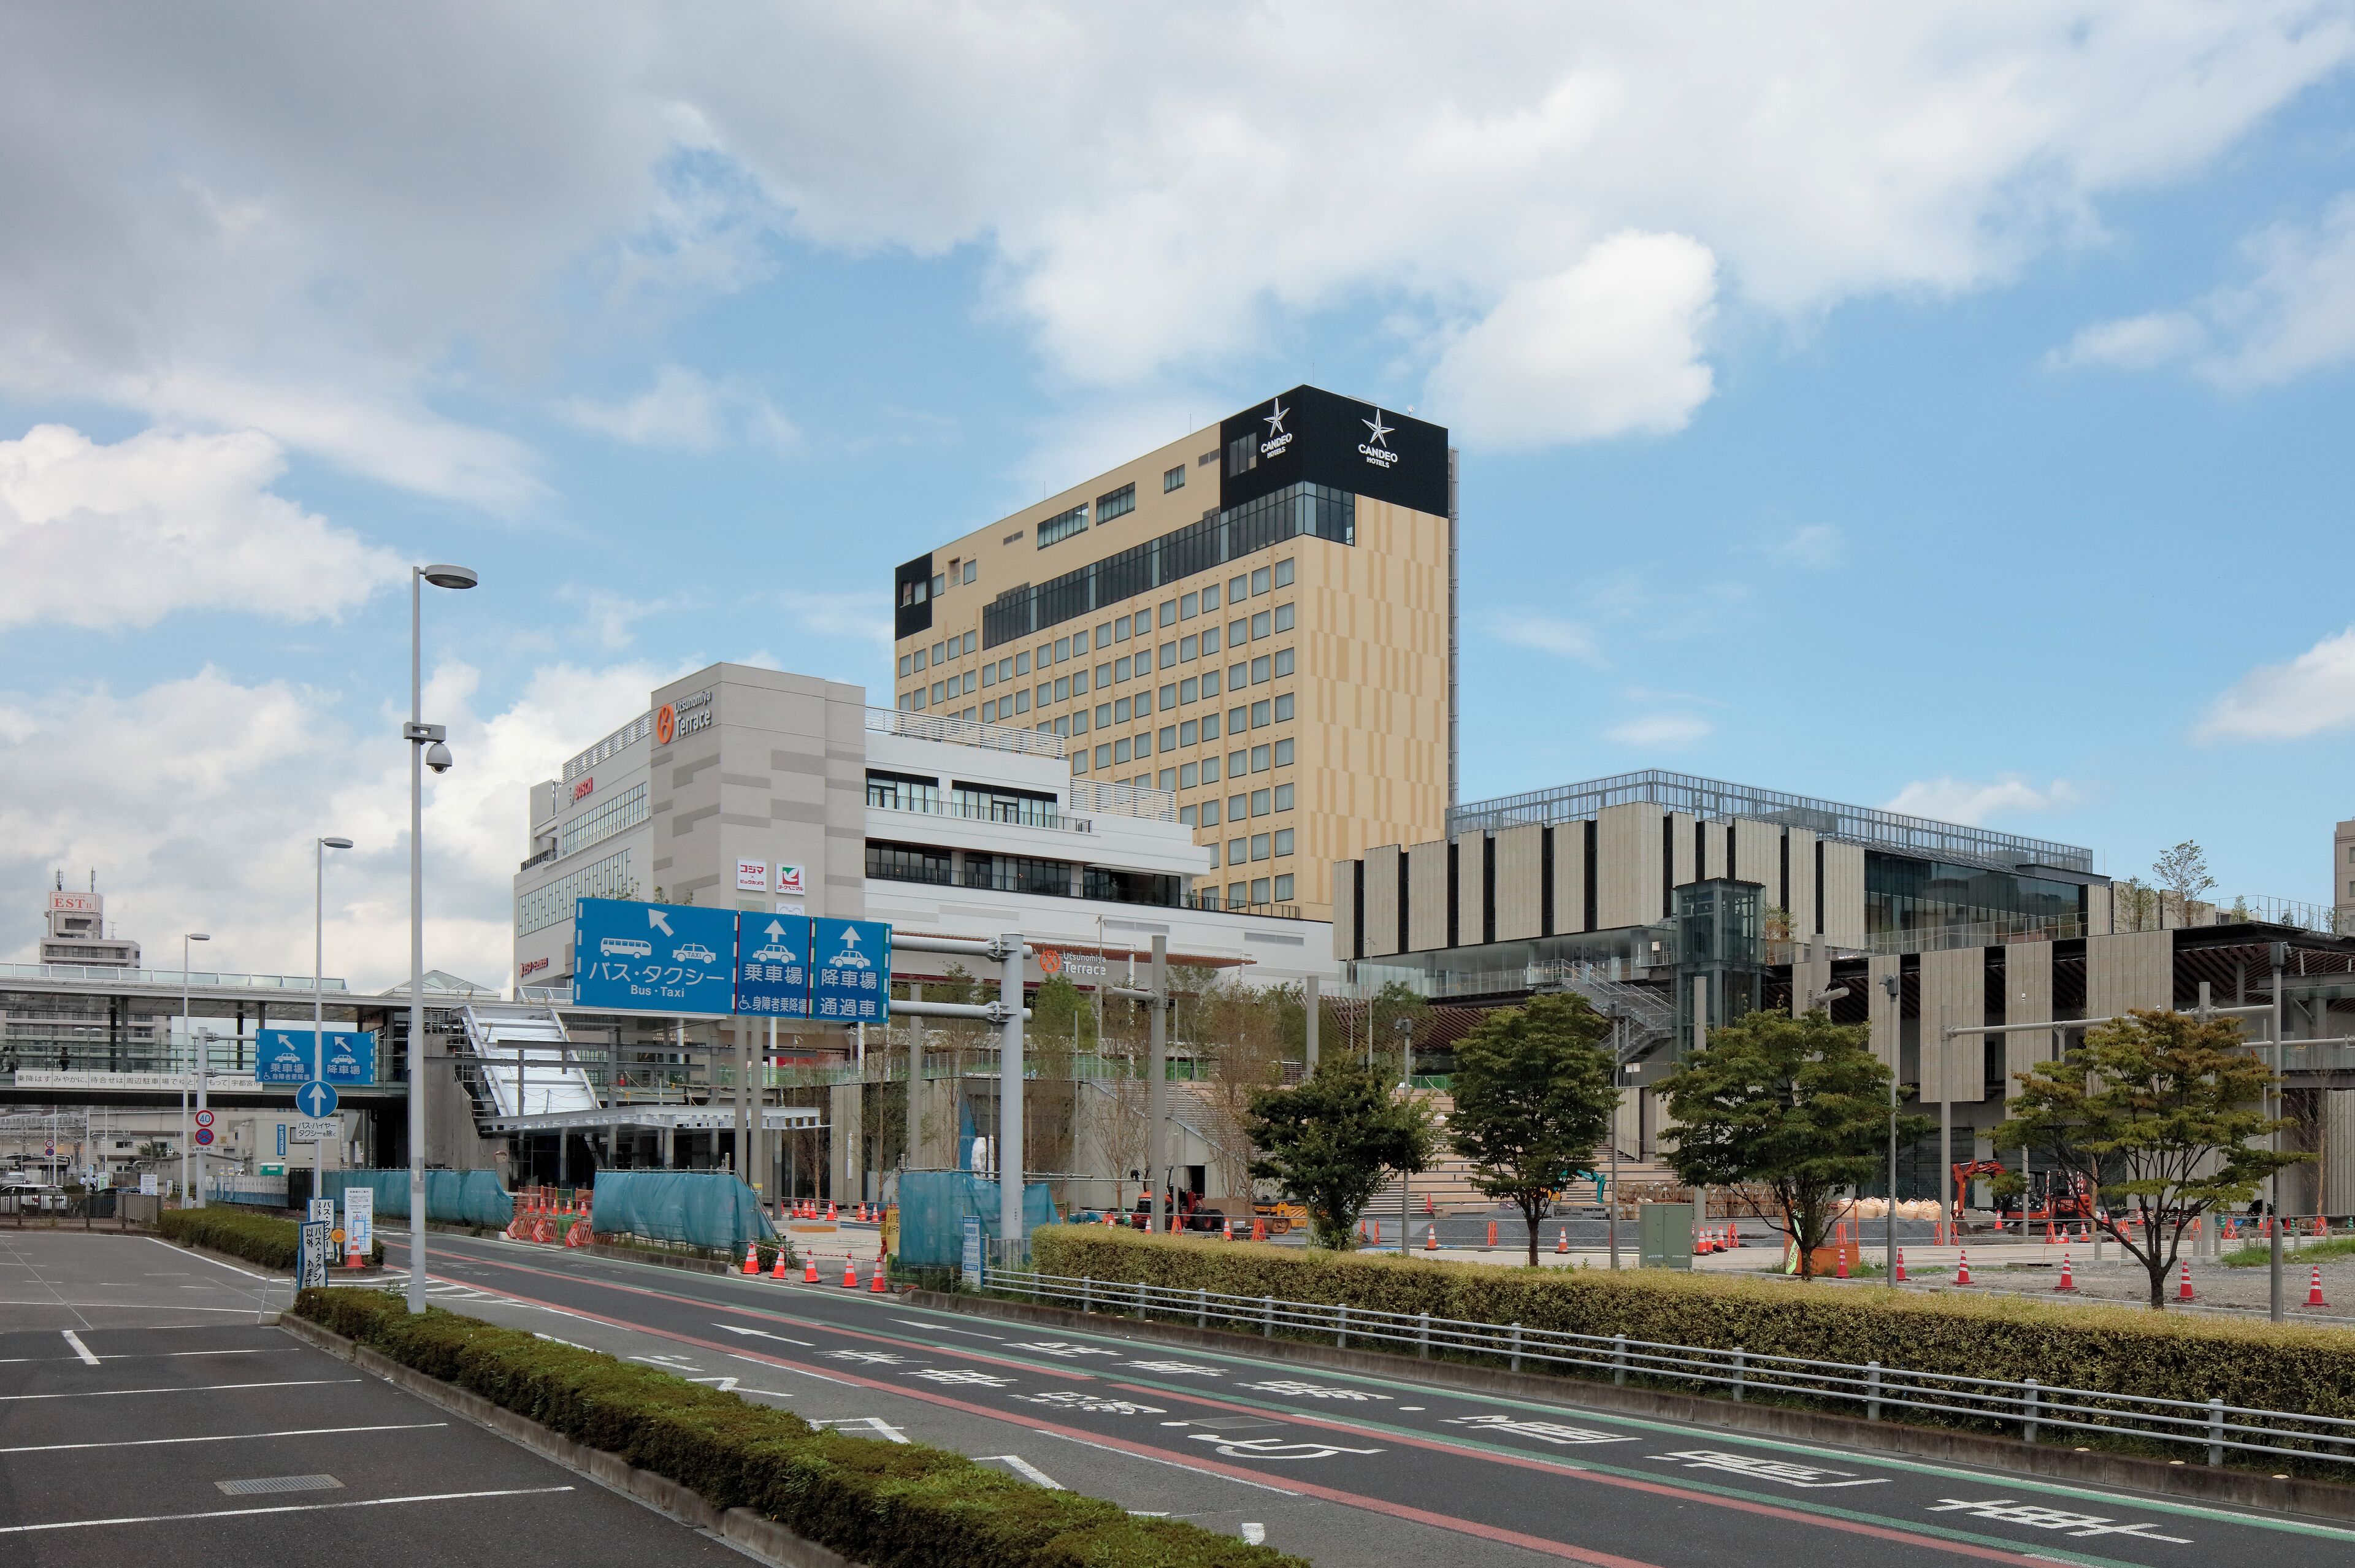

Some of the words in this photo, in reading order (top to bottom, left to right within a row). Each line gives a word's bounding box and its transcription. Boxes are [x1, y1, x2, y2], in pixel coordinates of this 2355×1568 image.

[1261, 433, 1293, 453] CANDEO
[1267, 446, 1286, 459] HOTELS
[1358, 444, 1398, 463] CANDEO
[1366, 457, 1390, 468] HOTELS
[675, 690, 711, 713] Utsunomiya
[675, 709, 711, 736] Terrace
[575, 777, 593, 800] BOSCH
[740, 865, 764, 874] コジマ
[54, 898, 85, 908] EST
[1063, 952, 1106, 963] Utsunomiya
[589, 962, 725, 985] バス・タクシー
[744, 963, 803, 985] 乗車場
[1063, 961, 1106, 976] Terrace
[821, 969, 878, 990] 降車場
[630, 984, 651, 996] Bus
[661, 987, 685, 998] Taxi
[752, 995, 808, 1014] 身障者乗降場
[820, 997, 876, 1017] 通過車
[270, 1063, 305, 1073] 乗車場
[327, 1065, 361, 1075] 降車場
[199, 1114, 210, 1123] 40
